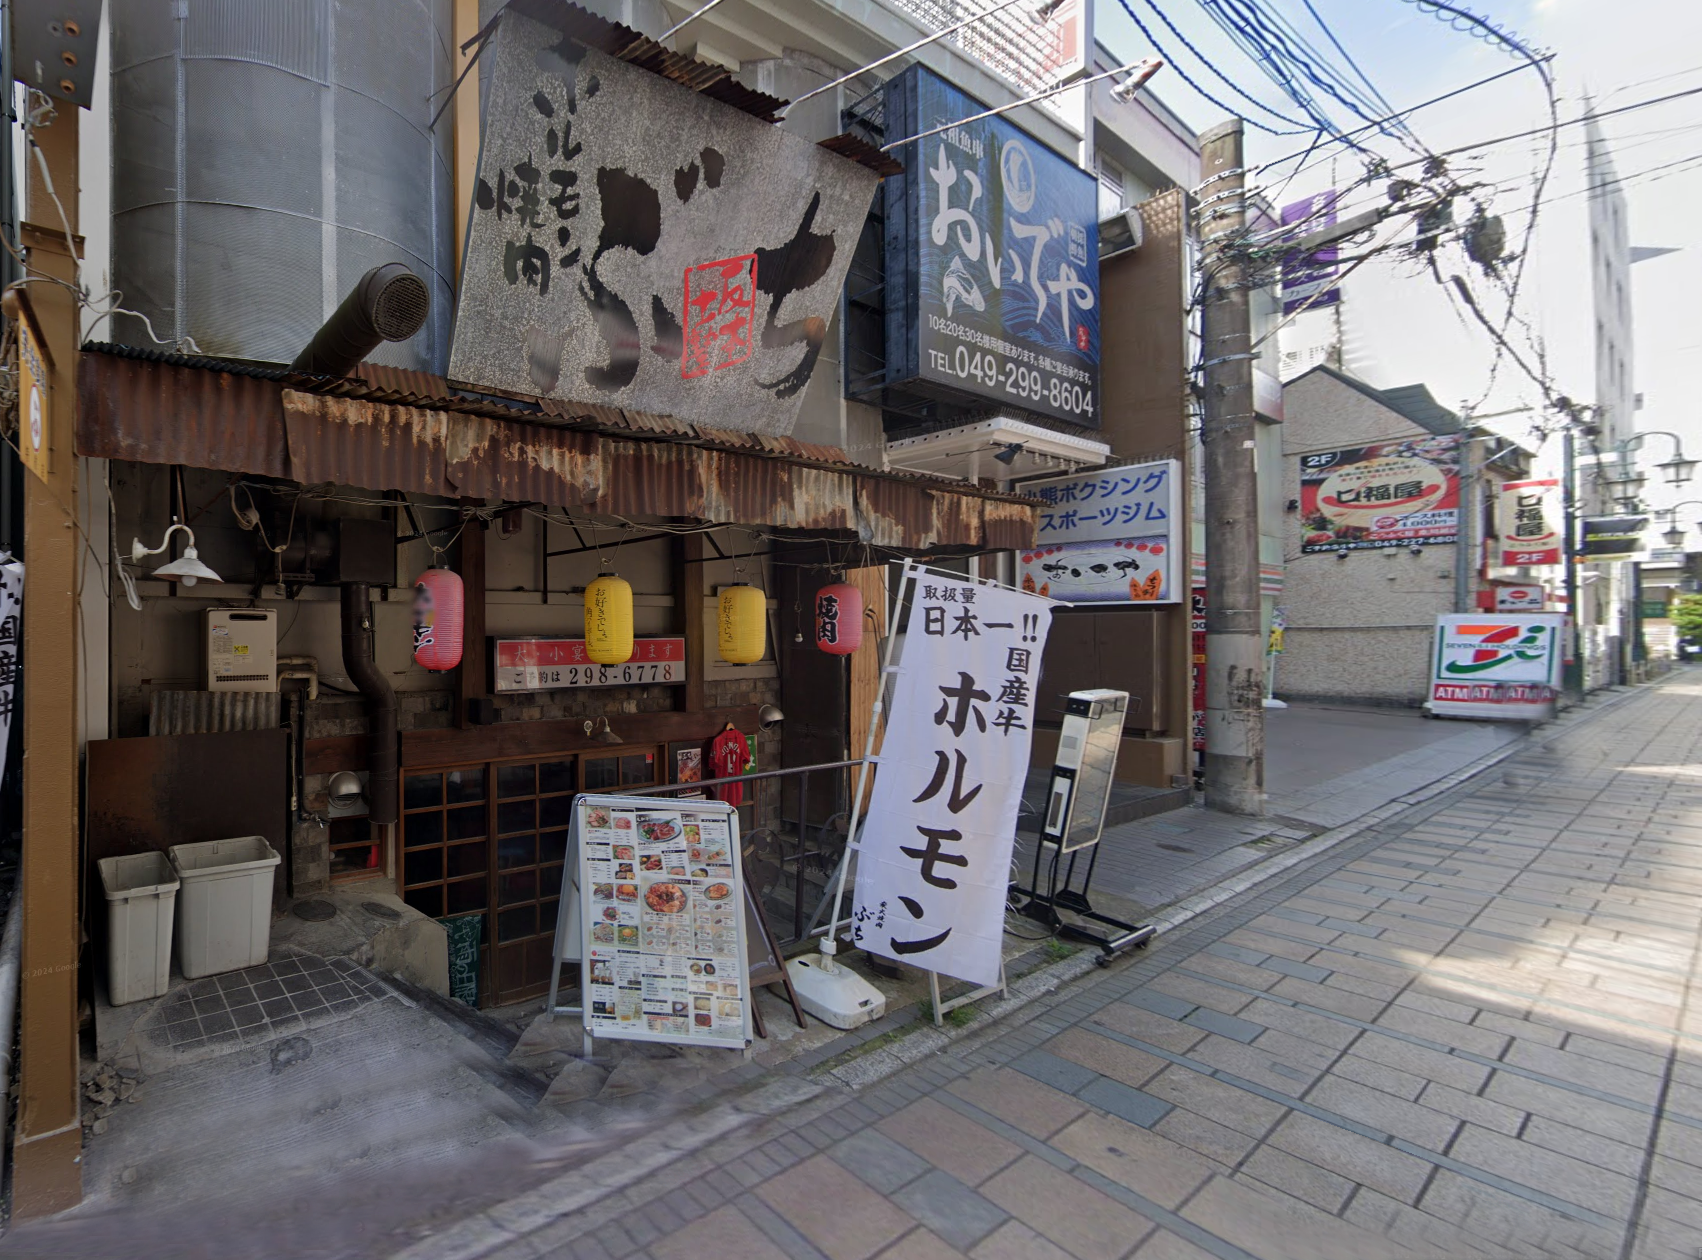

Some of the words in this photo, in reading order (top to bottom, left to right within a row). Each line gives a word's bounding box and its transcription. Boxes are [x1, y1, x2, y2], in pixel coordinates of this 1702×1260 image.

[477, 151, 549, 297] 焼肉
[929, 143, 1095, 344] おいでや
[1306, 454, 1333, 466] 2F
[1040, 502, 1166, 532] スポーツジム
[1516, 553, 1545, 562] 2F
[923, 585, 976, 604] 取扱量
[818, 594, 840, 644] 焼肉
[569, 664, 672, 685] 298-6778
[991, 647, 1032, 737] 国産牛
[1436, 686, 1468, 699] ATM
[890, 672, 992, 956] ホルモン
[855, 905, 875, 940] ぶち
